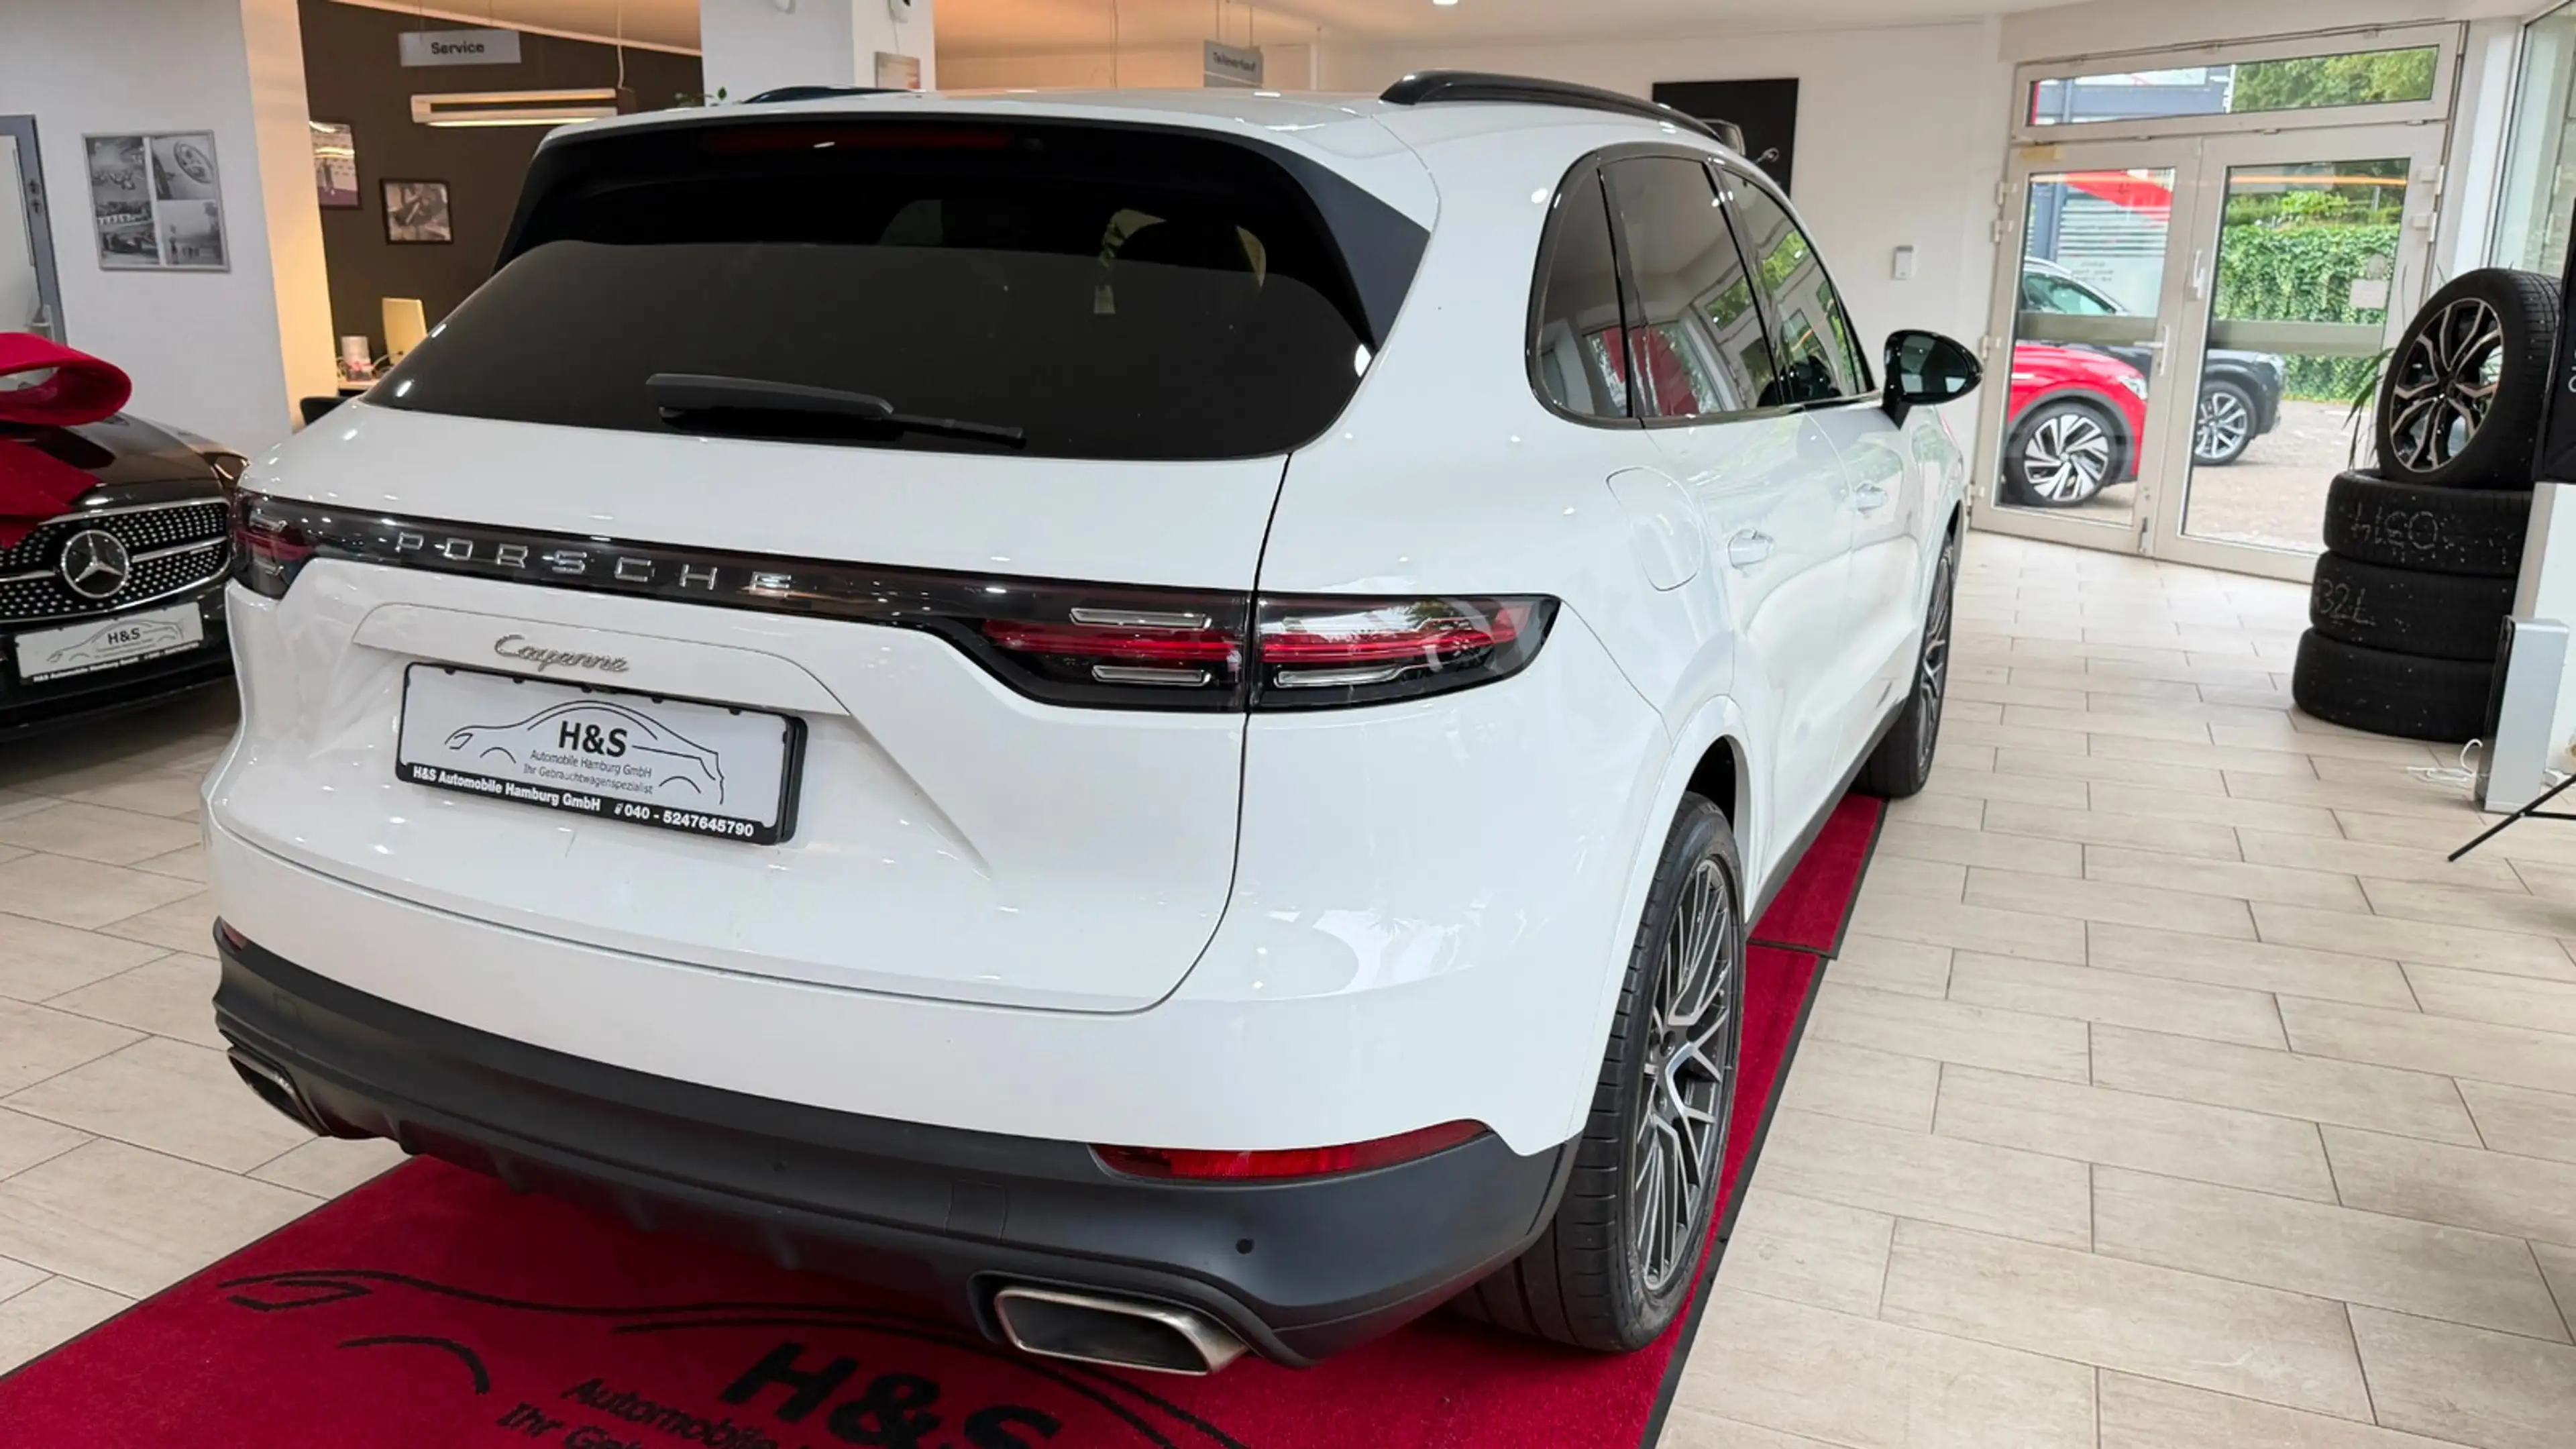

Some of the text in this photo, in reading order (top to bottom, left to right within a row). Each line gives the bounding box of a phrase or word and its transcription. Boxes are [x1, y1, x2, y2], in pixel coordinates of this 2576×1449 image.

[431, 40, 485, 55] Service
[394, 532, 793, 597] PORSCHE
[107, 627, 141, 645] H&S
[494, 634, 630, 672] Cayenne
[557, 720, 629, 758] H&S
[523, 762, 654, 795] Ihr Gebrauchtwagenspezialist
[529, 749, 653, 779] Automobile Hamburg GmbH
[413, 765, 437, 782] H&S
[437, 771, 502, 794] Automobile
[504, 782, 560, 806] Hamburg
[562, 792, 601, 811] GmbH
[623, 803, 651, 820] 040
[662, 809, 754, 837] 5247645790
[720, 1342, 1063, 1449] H&S
[496, 1402, 565, 1438] Ihr
